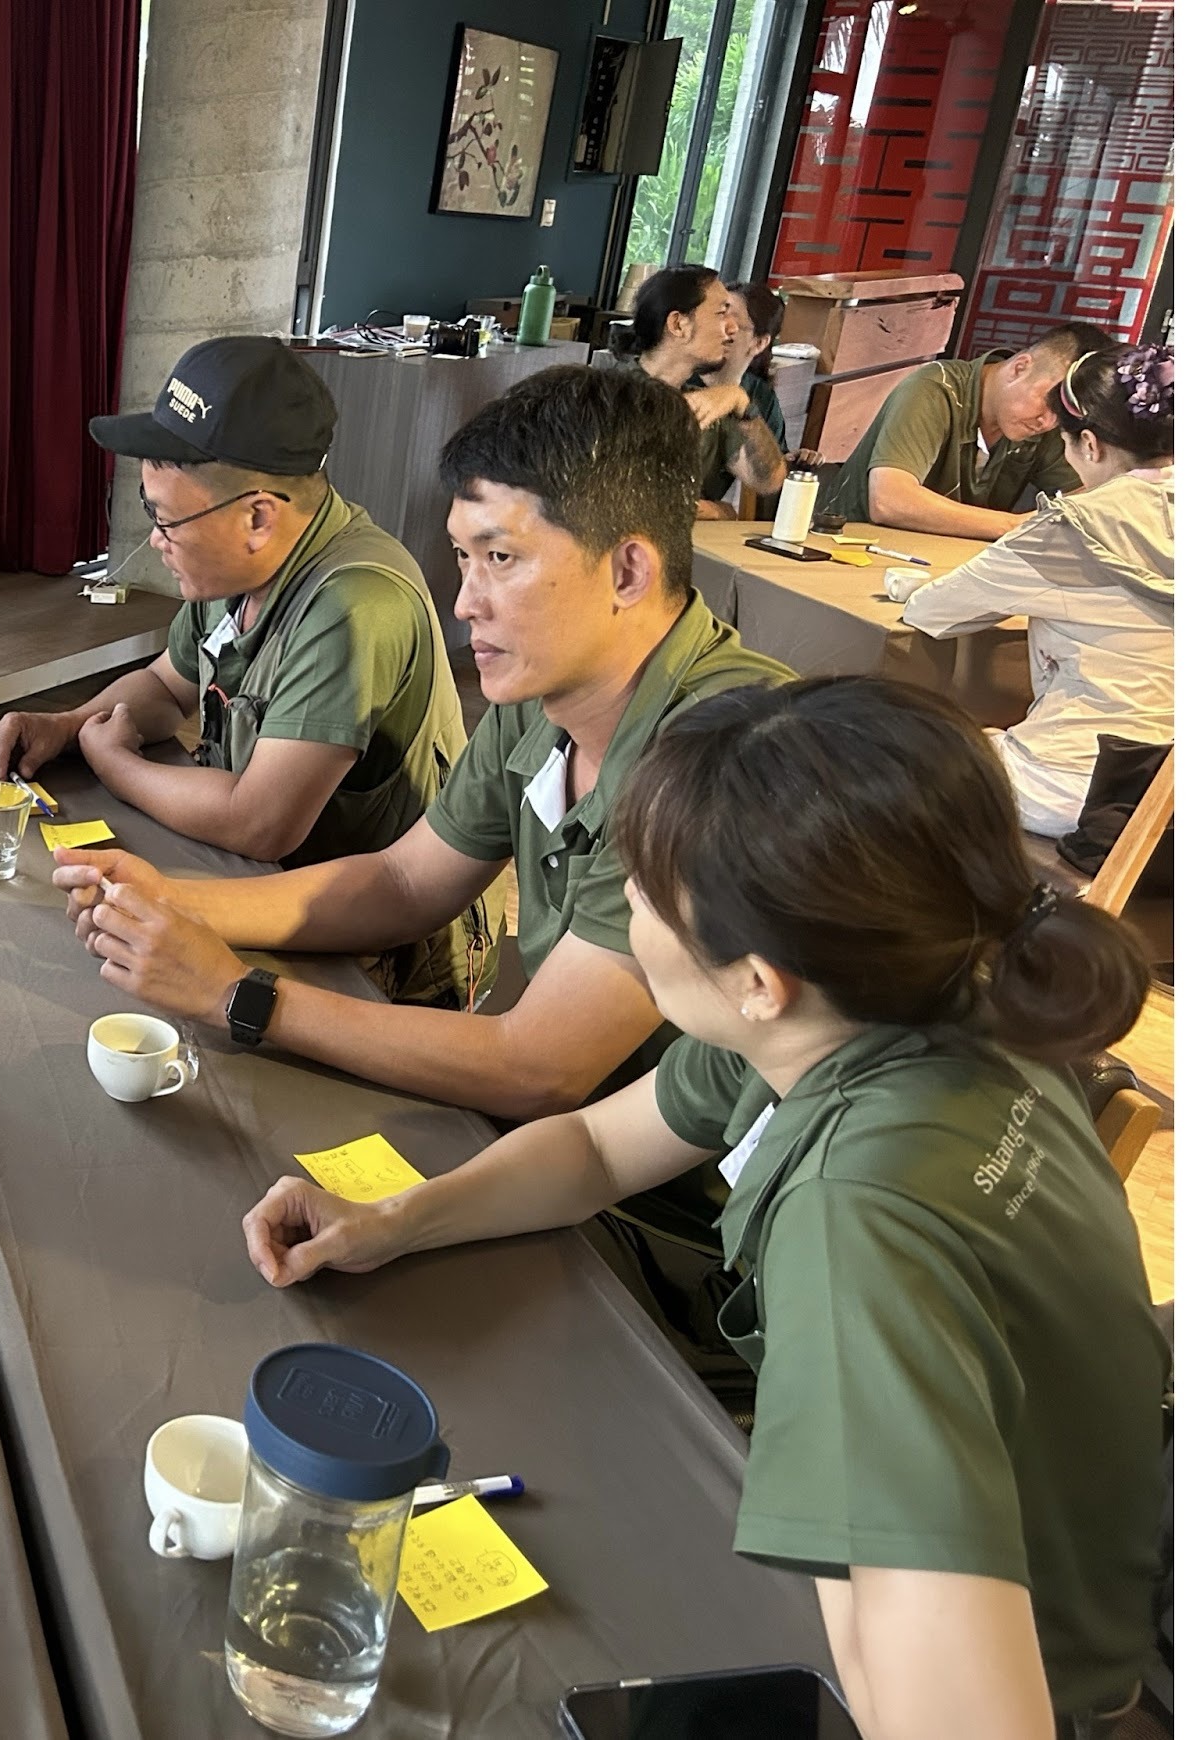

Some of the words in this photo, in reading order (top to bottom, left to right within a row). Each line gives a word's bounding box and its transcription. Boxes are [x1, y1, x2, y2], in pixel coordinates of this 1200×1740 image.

[167, 377, 199, 411] PUMA
[168, 397, 197, 424] SUEDE
[973, 1122, 1026, 1194] Shiang
[1005, 1180, 1036, 1220] since
